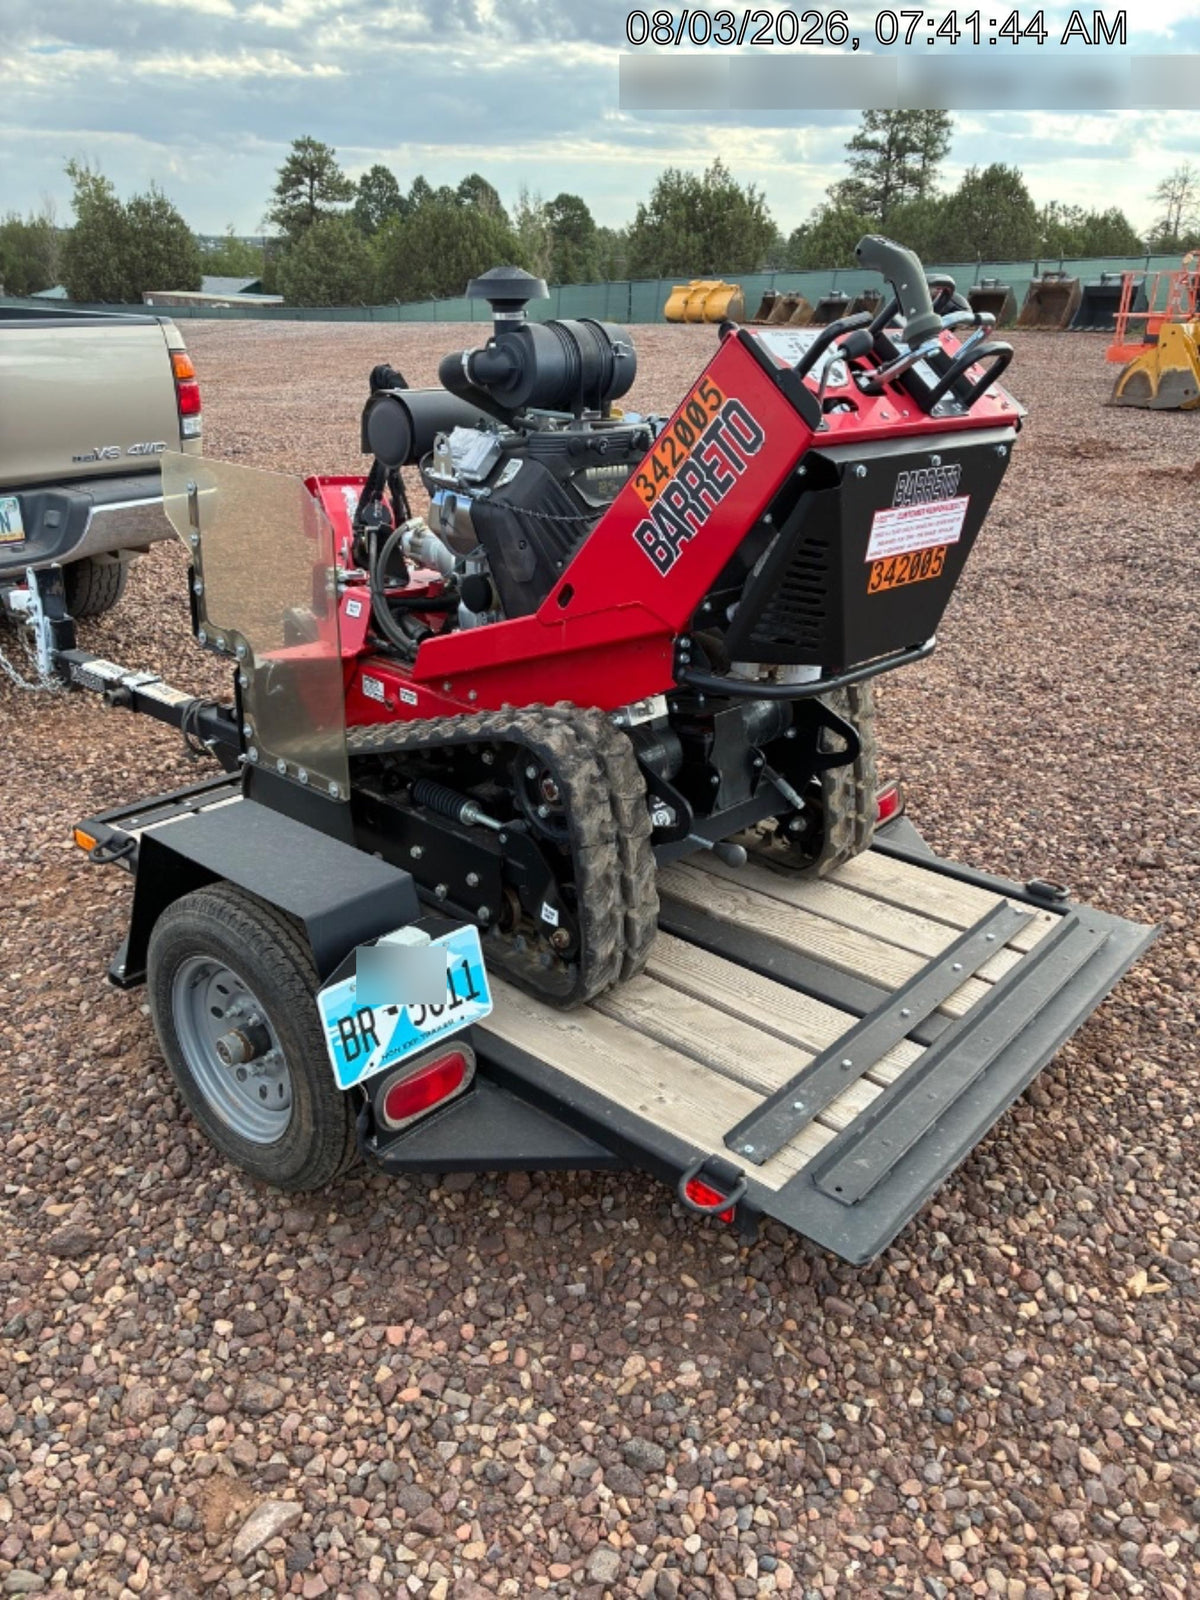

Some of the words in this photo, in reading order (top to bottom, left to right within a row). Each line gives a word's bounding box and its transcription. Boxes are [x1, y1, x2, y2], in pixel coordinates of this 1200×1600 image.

[634, 380, 724, 502] 342005
[632, 398, 765, 578] BARRETO
[892, 464, 962, 508] BARRETO
[871, 547, 945, 591] 342005
